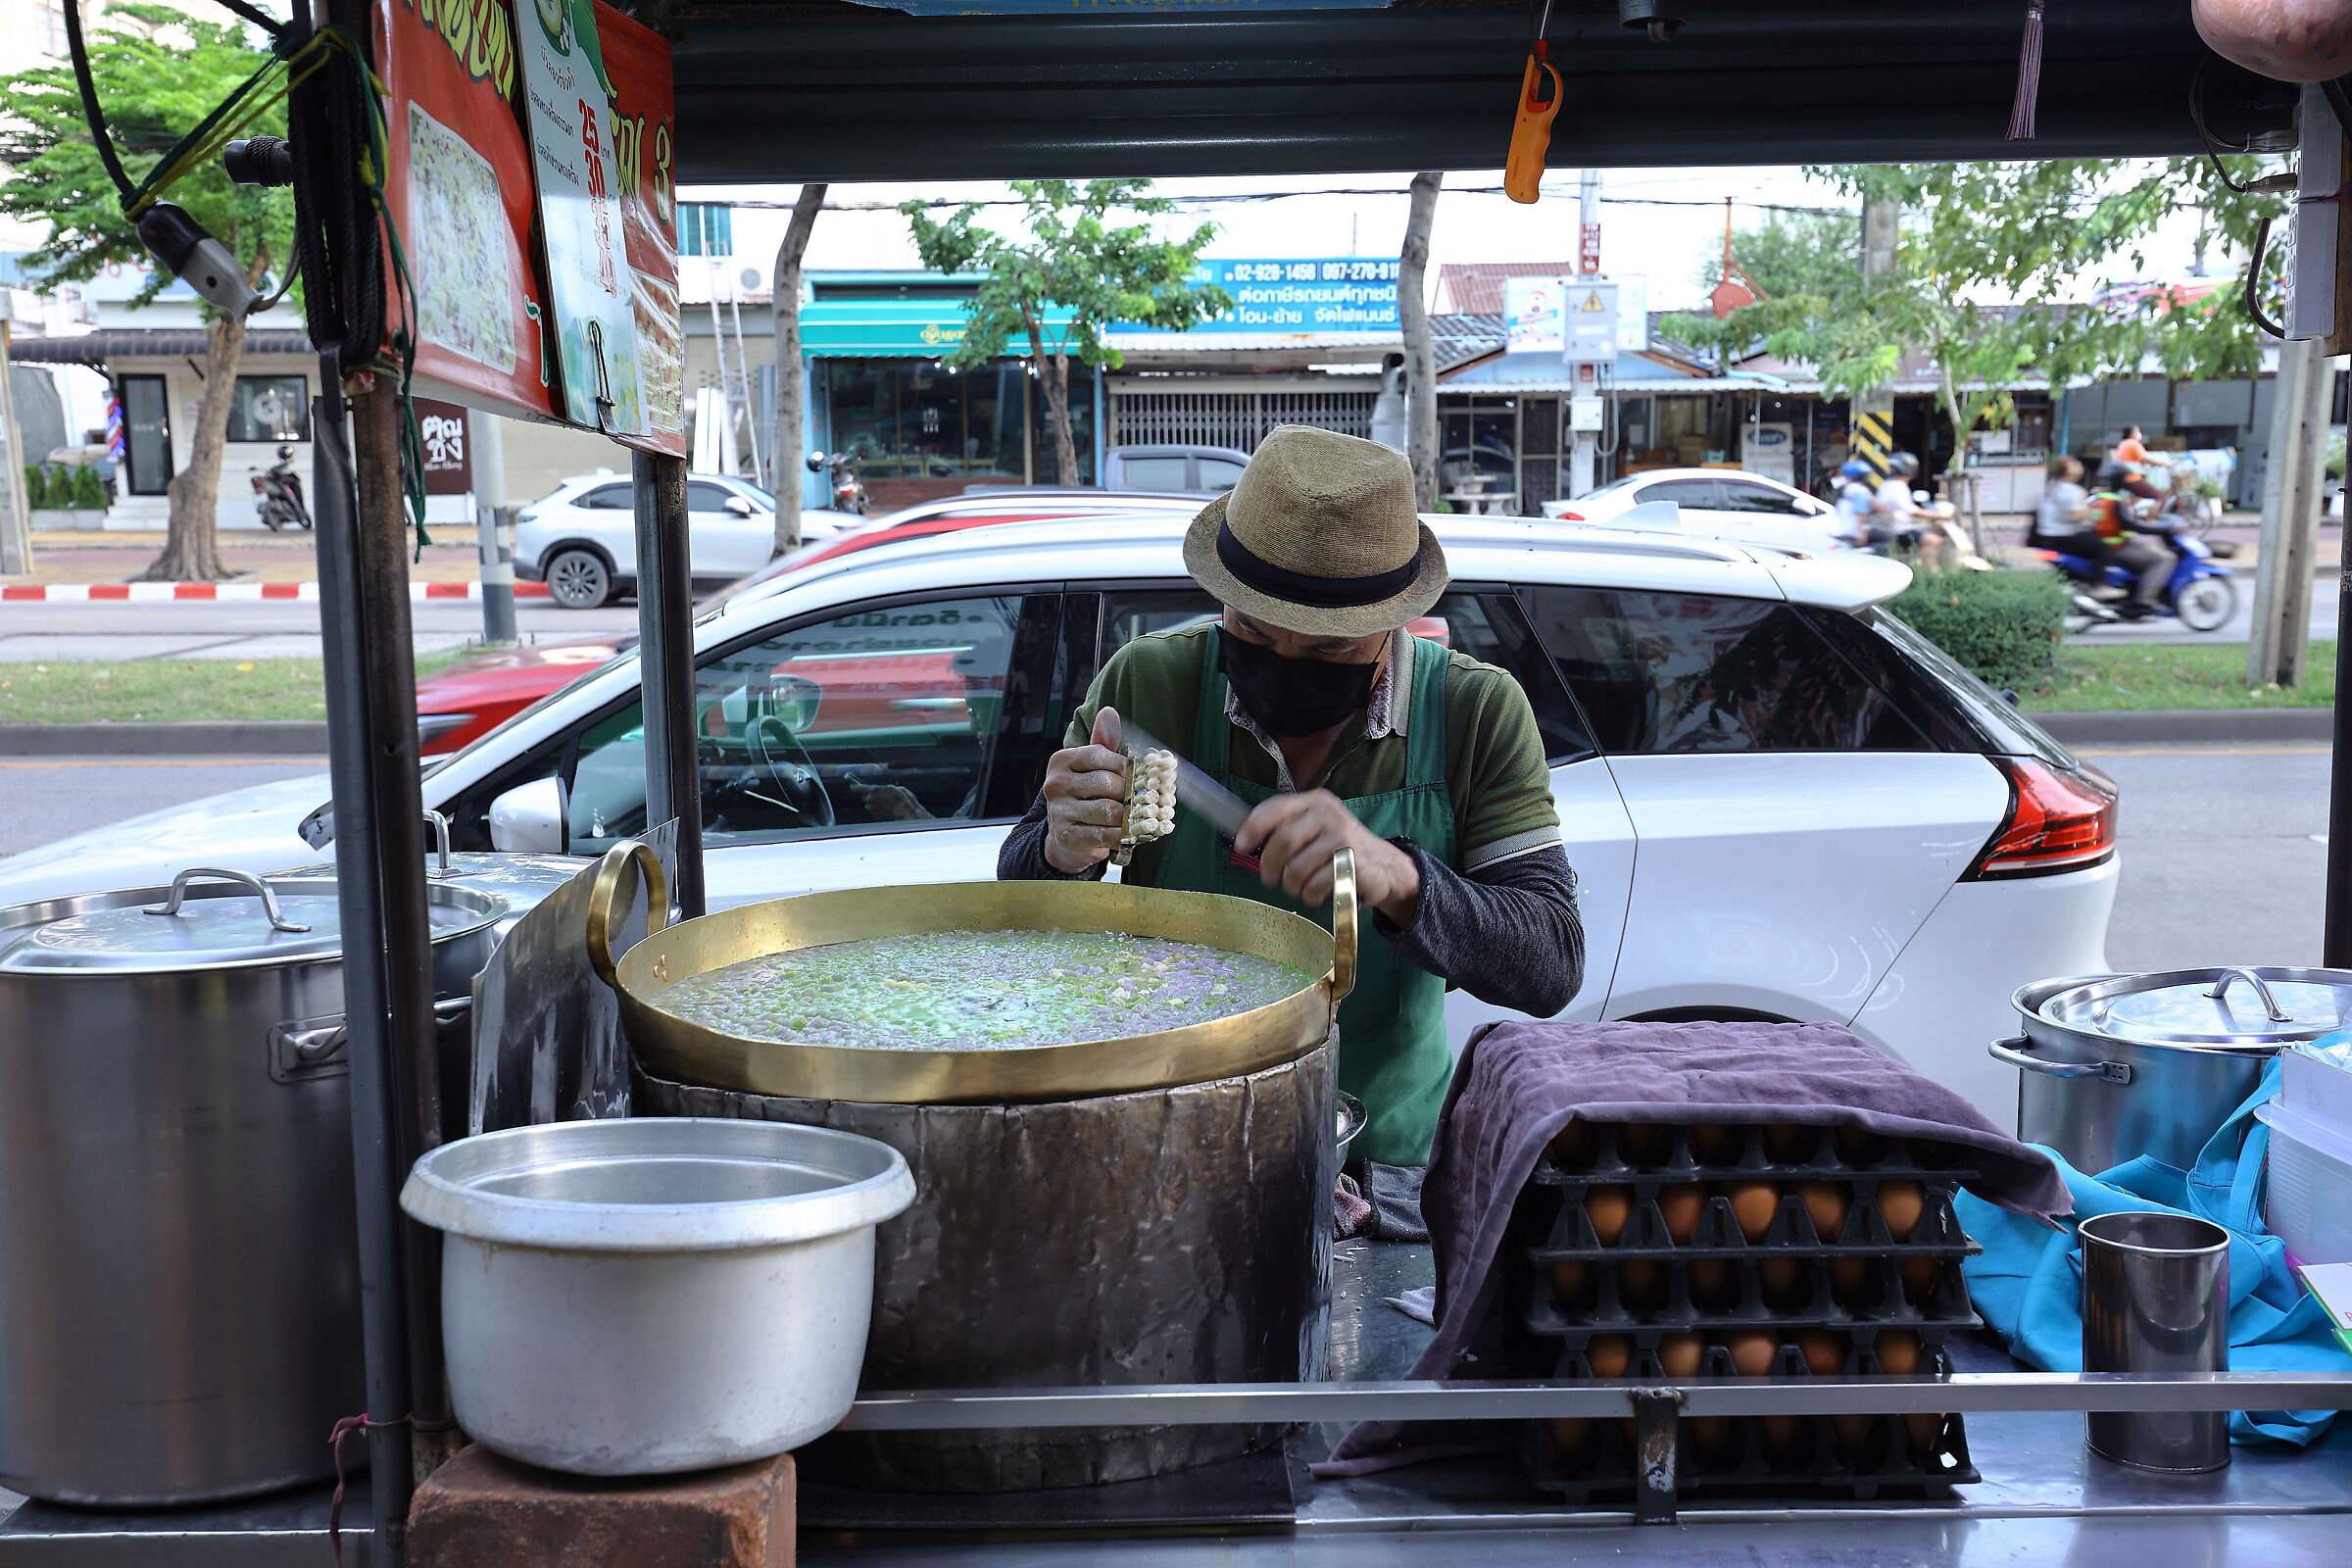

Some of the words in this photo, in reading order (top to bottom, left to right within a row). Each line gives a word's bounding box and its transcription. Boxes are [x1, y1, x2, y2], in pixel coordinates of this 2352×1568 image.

[579, 99, 599, 154] 25
[585, 149, 606, 200] 30
[655, 124, 671, 220] 3
[1239, 306, 1302, 323] โอน-ย้าย
[421, 415, 464, 442] คุณ
